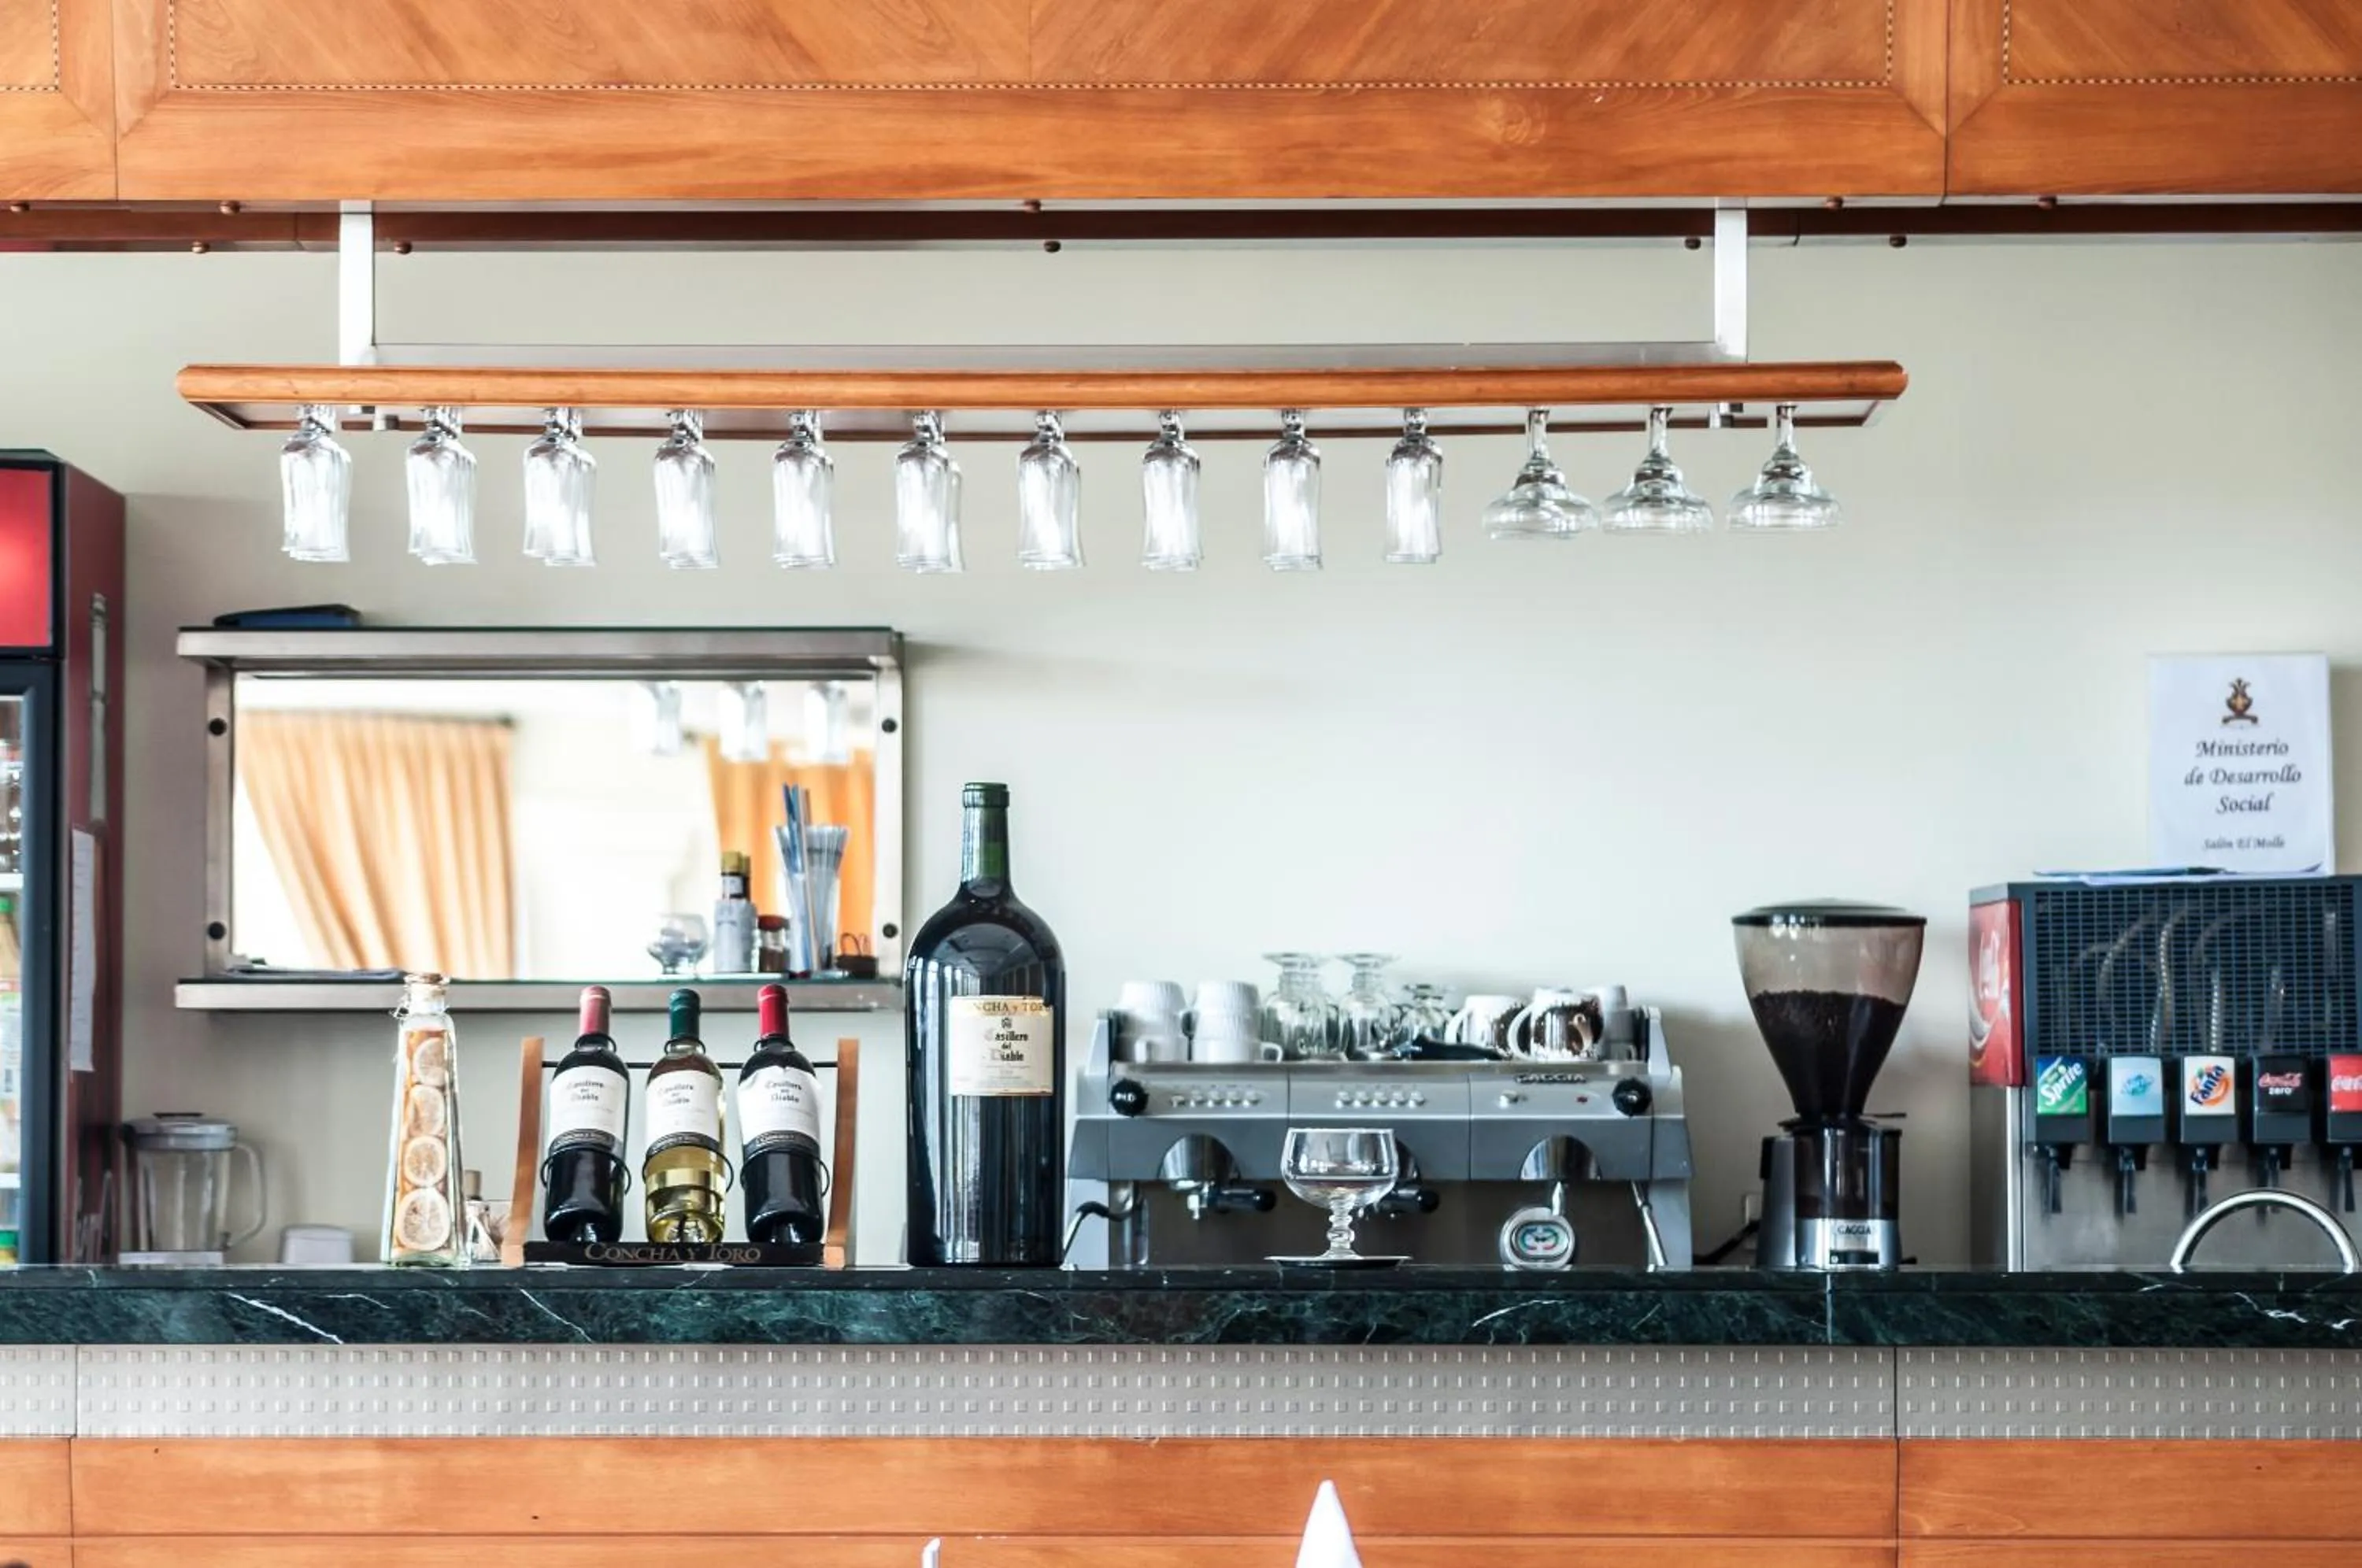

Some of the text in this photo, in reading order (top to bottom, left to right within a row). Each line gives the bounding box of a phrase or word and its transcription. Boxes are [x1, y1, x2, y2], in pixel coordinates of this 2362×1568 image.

[2195, 738, 2289, 758] Ministerio
[2184, 764, 2301, 786] de Desarrollo
[2216, 792, 2275, 815] Social
[2040, 1062, 2083, 1106] Sprite
[2190, 1064, 2226, 1106] Fanta
